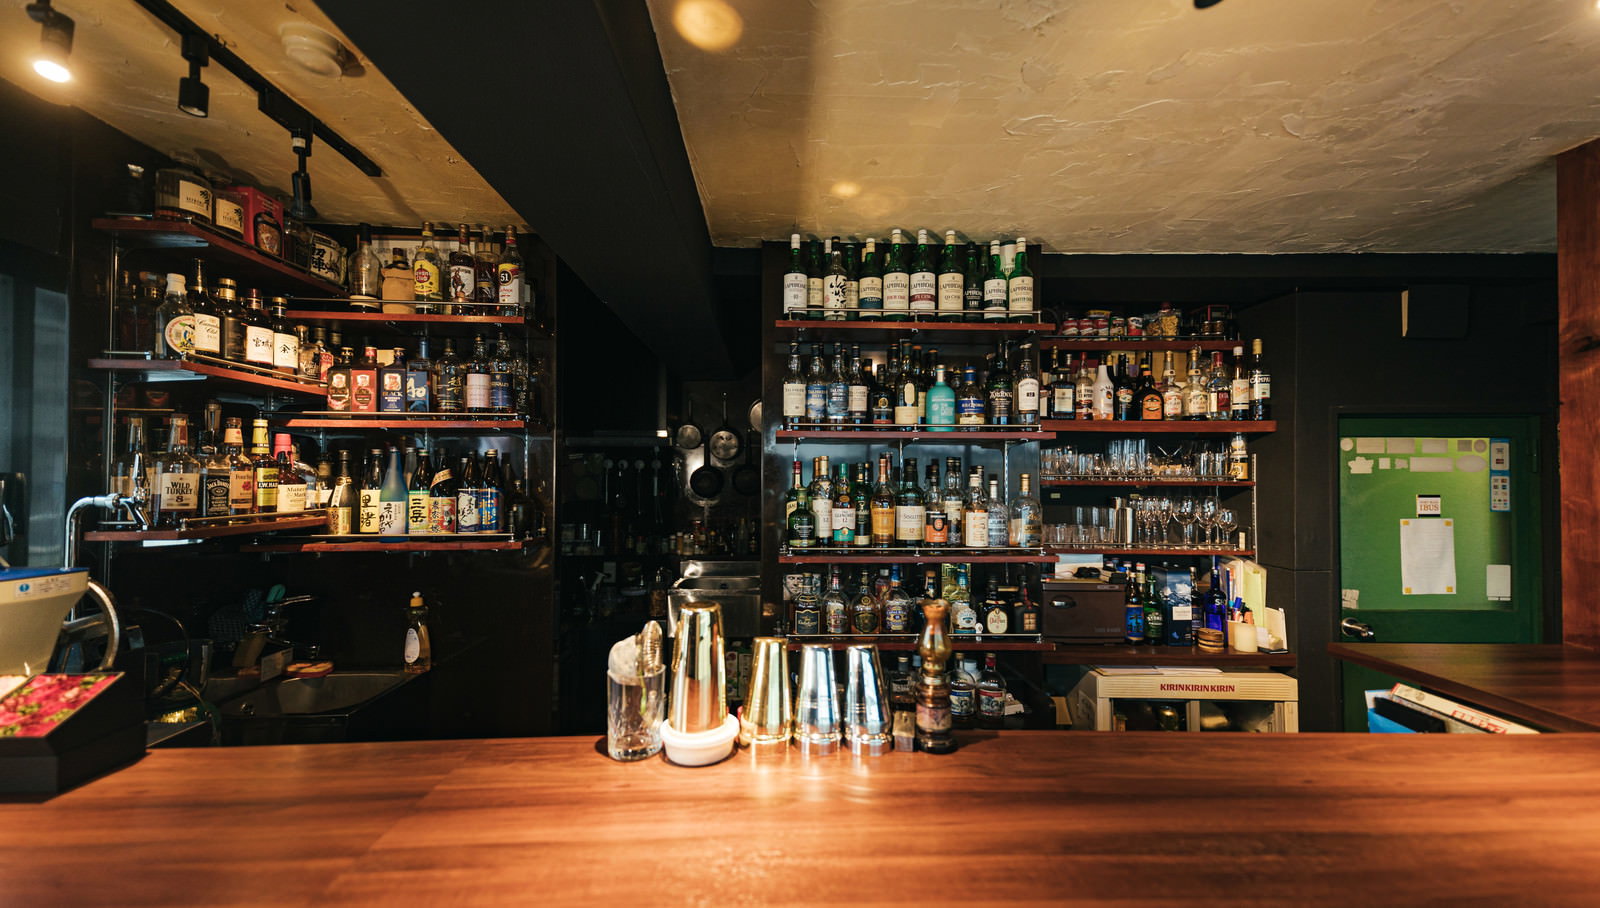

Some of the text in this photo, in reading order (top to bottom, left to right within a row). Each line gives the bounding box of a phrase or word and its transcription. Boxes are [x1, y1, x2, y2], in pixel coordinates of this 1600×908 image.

[500, 273, 510, 282] 51
[170, 481, 191, 489] WILD
[165, 486, 193, 495] TURKEY
[410, 498, 428, 523] 三岳
